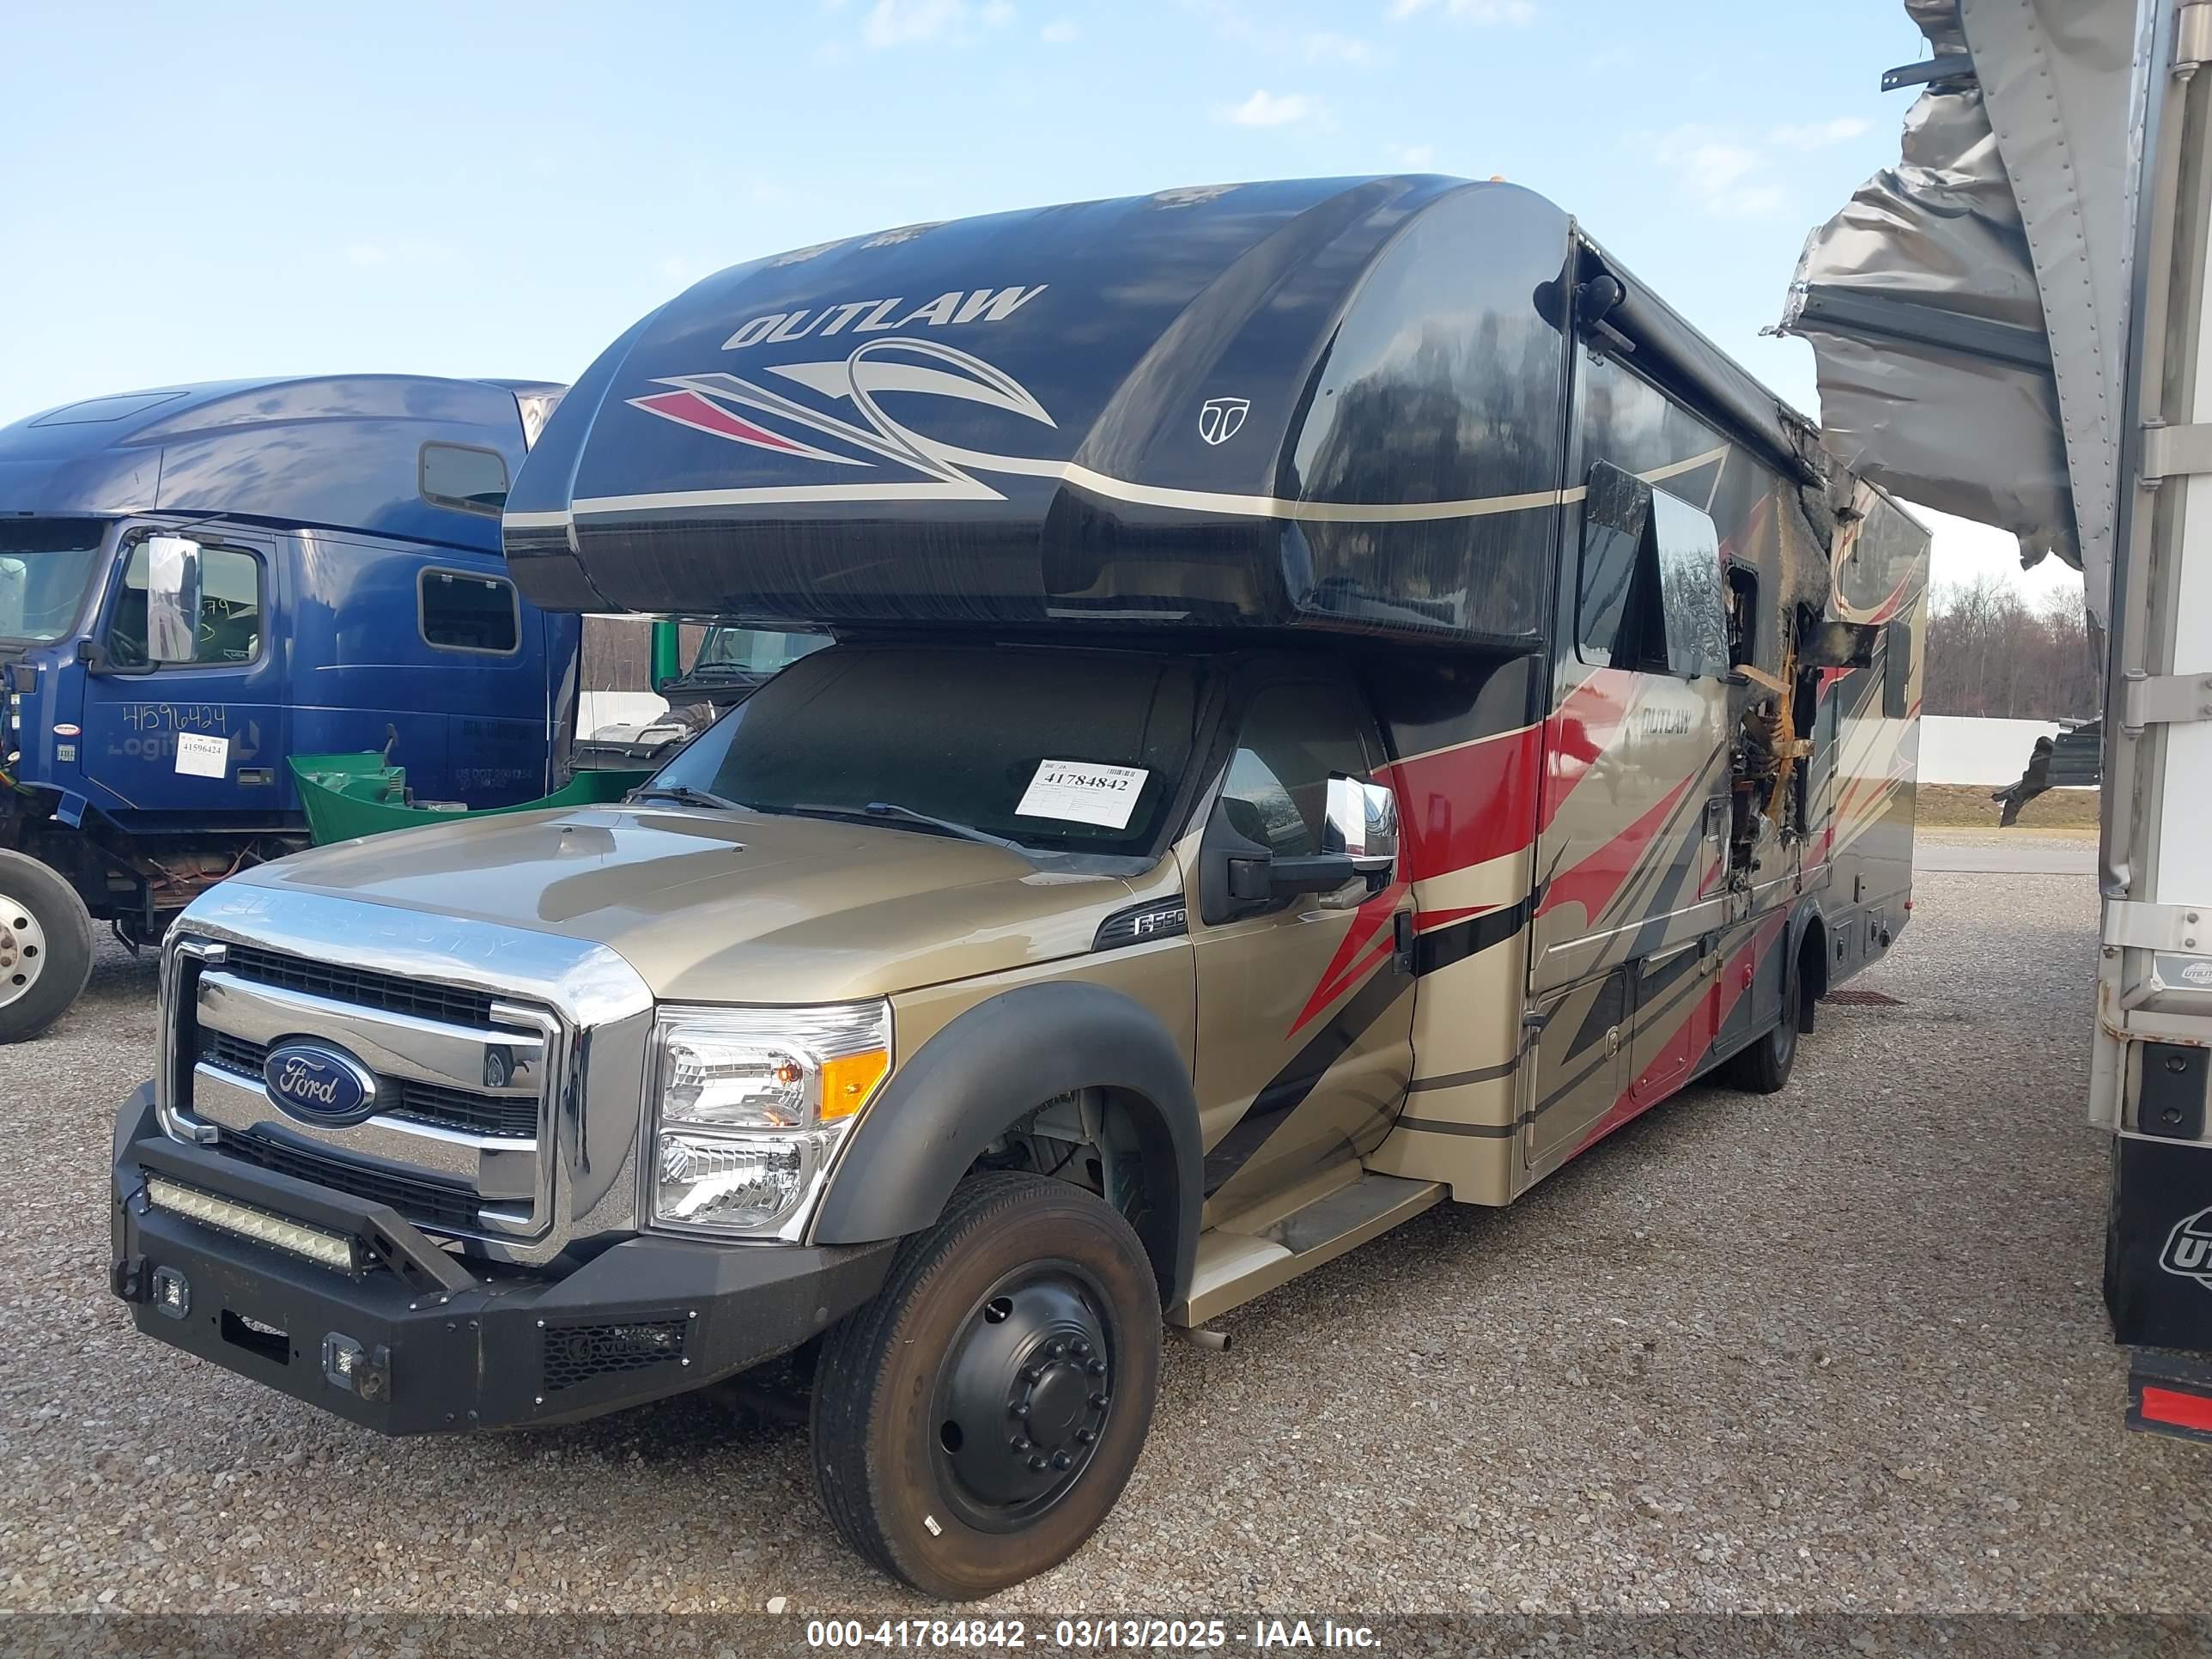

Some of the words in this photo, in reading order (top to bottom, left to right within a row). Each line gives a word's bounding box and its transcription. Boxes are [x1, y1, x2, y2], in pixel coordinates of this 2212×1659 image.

[720, 283, 1049, 350] OUTLAW
[122, 703, 227, 734] 41596424
[1642, 708, 1691, 734] OUTLAW
[183, 743, 221, 755] 41596424
[1044, 773, 1129, 792] 41784842
[279, 1056, 339, 1103] Ford
